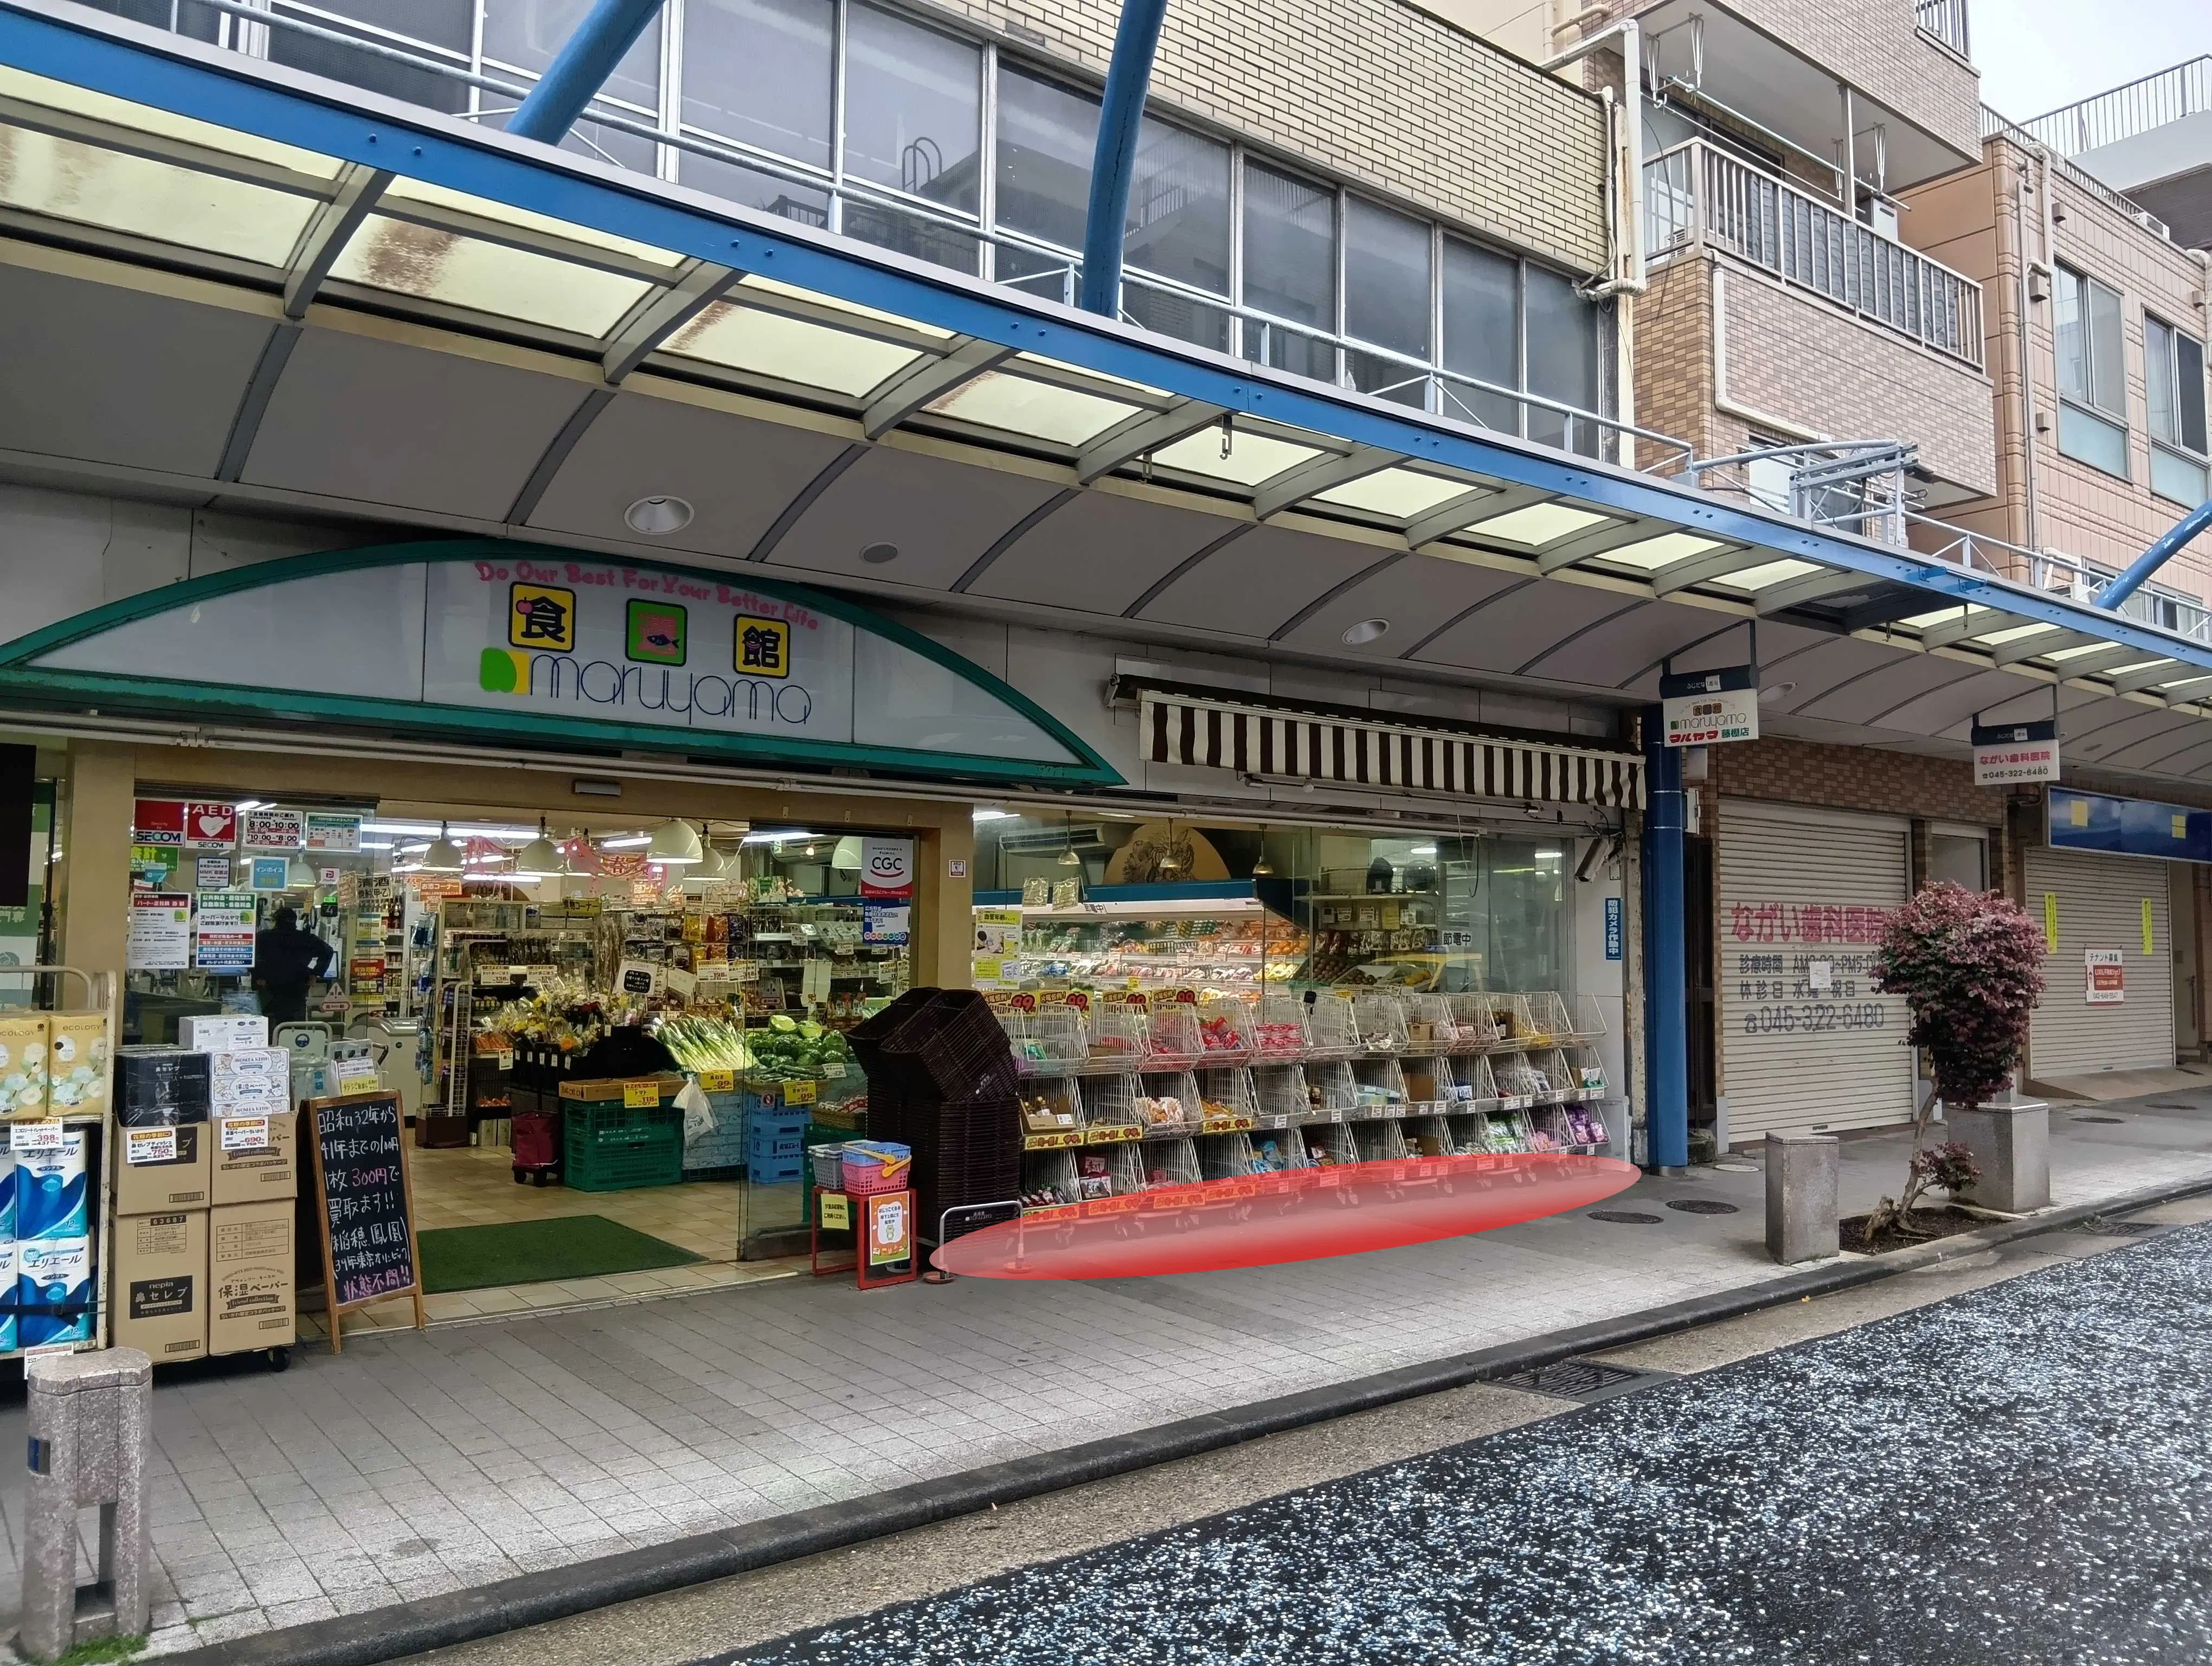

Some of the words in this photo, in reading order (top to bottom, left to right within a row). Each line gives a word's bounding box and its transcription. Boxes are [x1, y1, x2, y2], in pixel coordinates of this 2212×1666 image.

[474, 560, 509, 581] Do
[516, 559, 558, 582] Our
[564, 562, 615, 586] Best
[623, 568, 659, 591] For
[662, 574, 710, 600] Your
[716, 584, 778, 616] Better
[530, 653, 812, 725] maruyama
[1681, 713, 1746, 729] maruyama
[1669, 730, 1719, 744] マルヤマ
[1980, 751, 2050, 765] ながい歯科医院
[1989, 768, 2048, 778] 045-322-6480
[192, 804, 233, 816] AED
[137, 831, 181, 842] SECOM
[872, 856, 903, 870] CGC
[421, 882, 459, 890] お酒コーナー
[1607, 899, 1619, 955] 防犯カメラ作動中
[1443, 932, 1471, 946] 節電中
[1739, 954, 1783, 974] 診療時間
[2089, 953, 2118, 962] テナント募集
[1762, 1003, 1885, 1033] 045-322-6480
[23, 1146, 78, 1159] エリエール
[65, 1220, 75, 1228] 12
[153, 1216, 184, 1225] 63687
[28, 1254, 82, 1268] エリエール
[149, 1280, 174, 1290] nepia
[218, 1281, 289, 1299] 保湿ペーパー
[135, 1286, 188, 1303] 鼻セレブ
